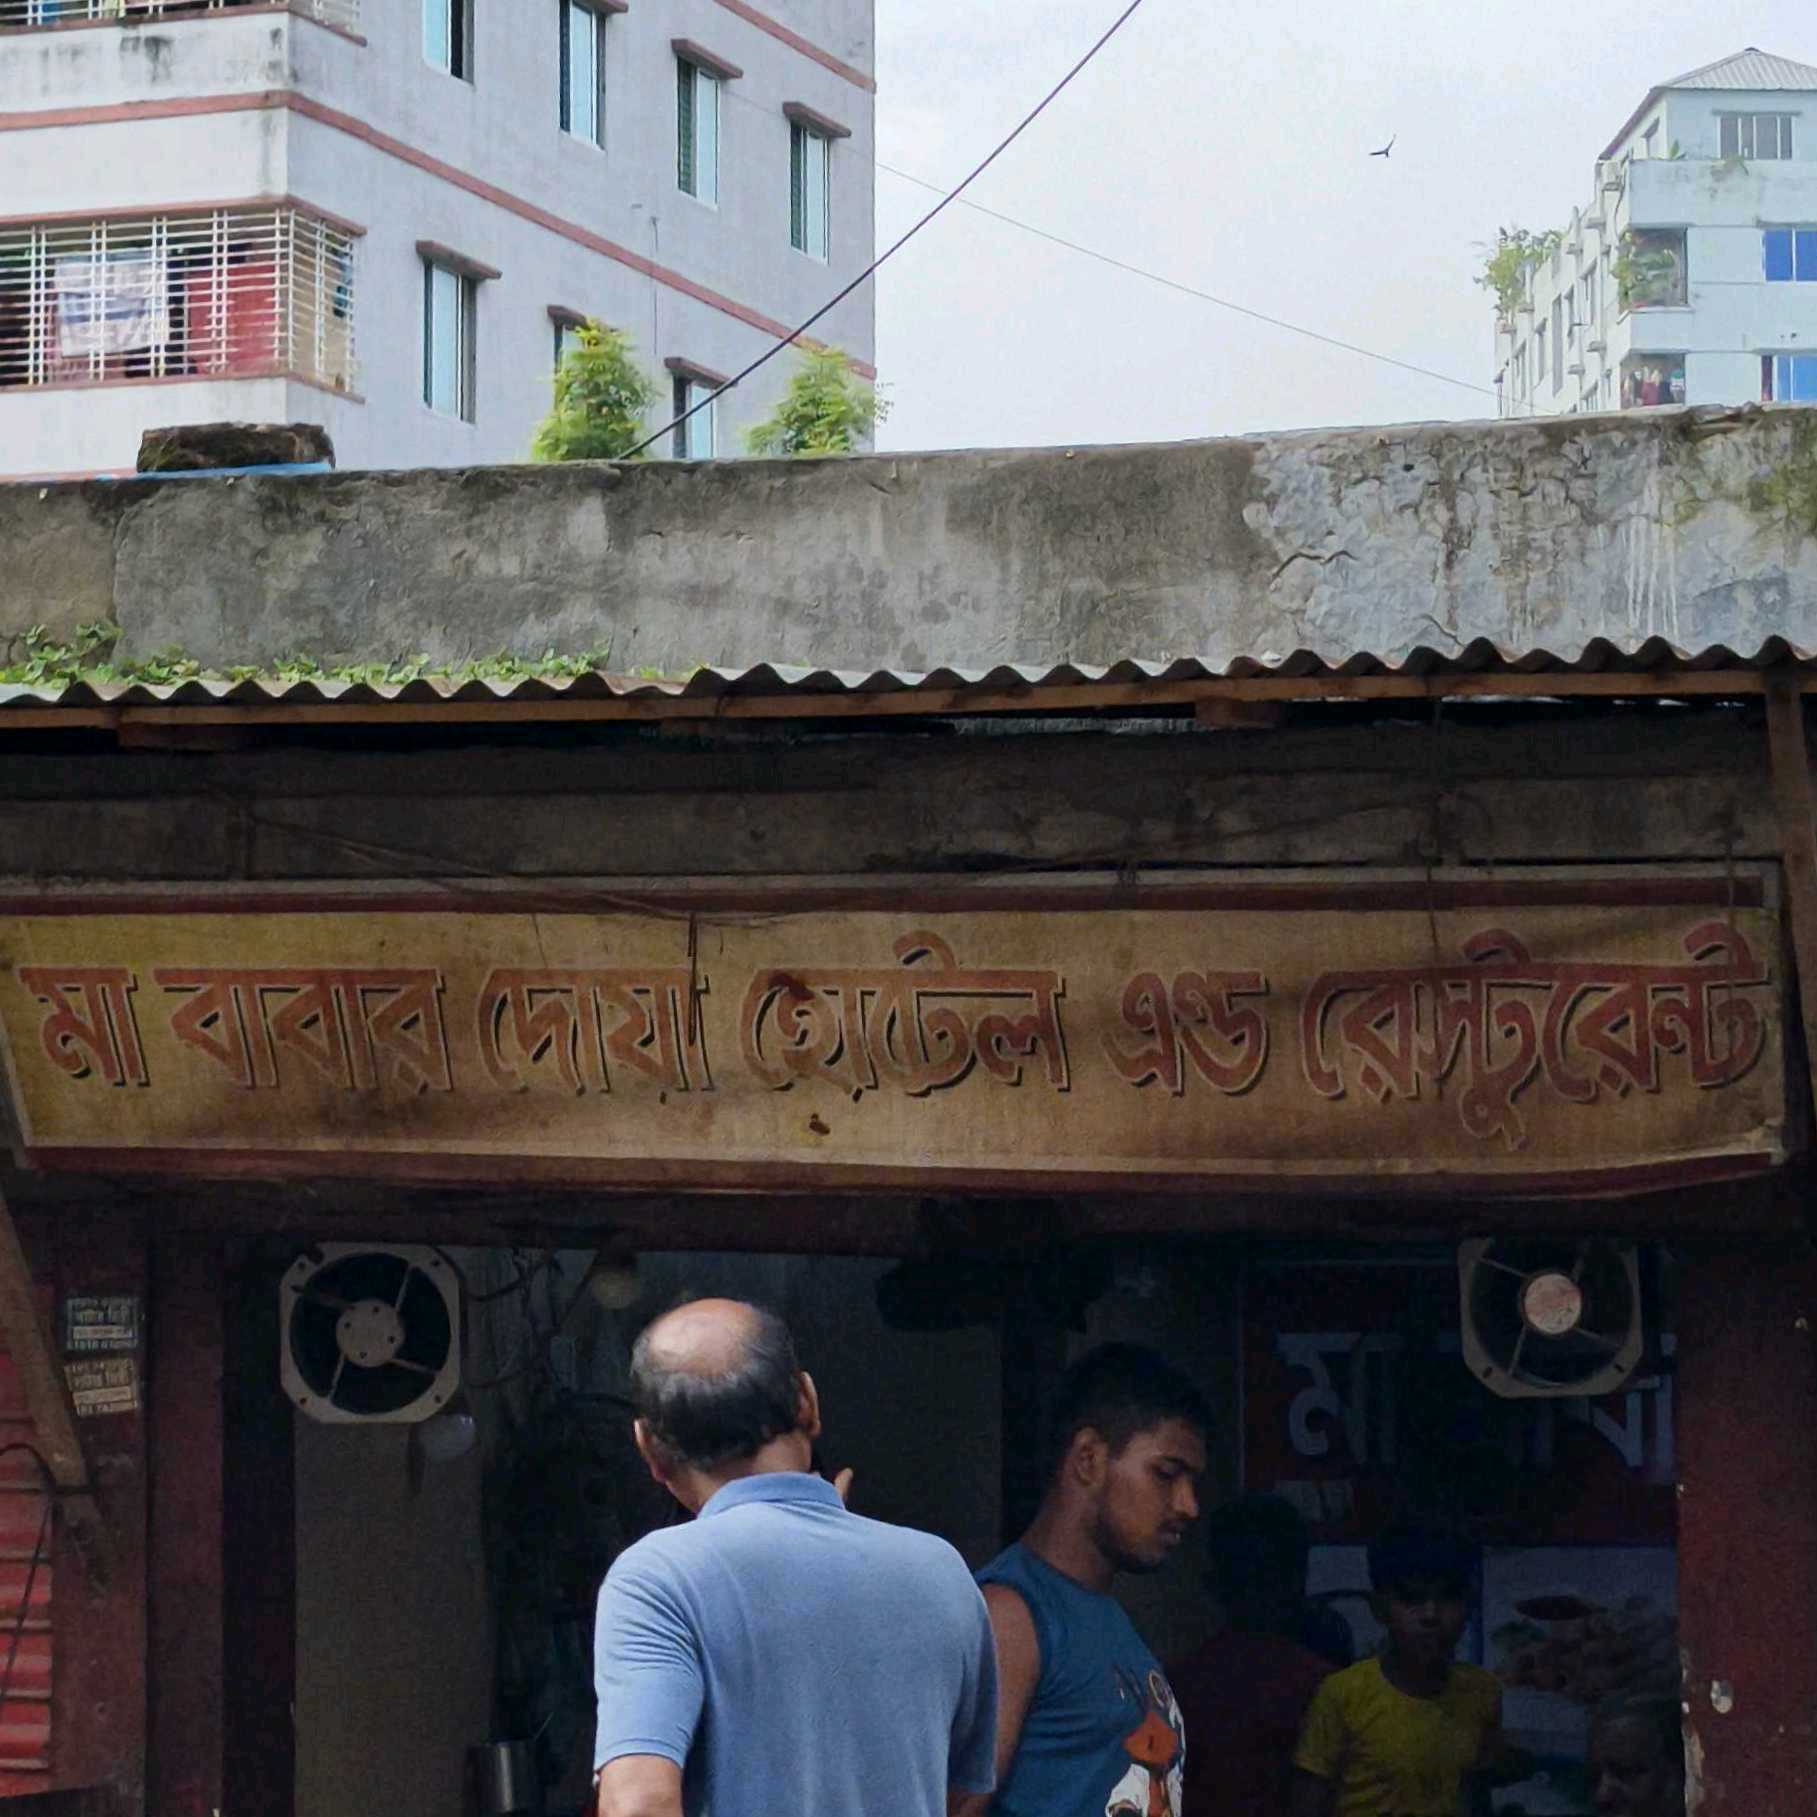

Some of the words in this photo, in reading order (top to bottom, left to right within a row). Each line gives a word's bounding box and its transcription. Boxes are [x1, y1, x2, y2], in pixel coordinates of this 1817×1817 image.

[18, 965, 152, 1087] মা
[152, 965, 454, 1093] বাবার
[738, 929, 1071, 1101] হোটেল
